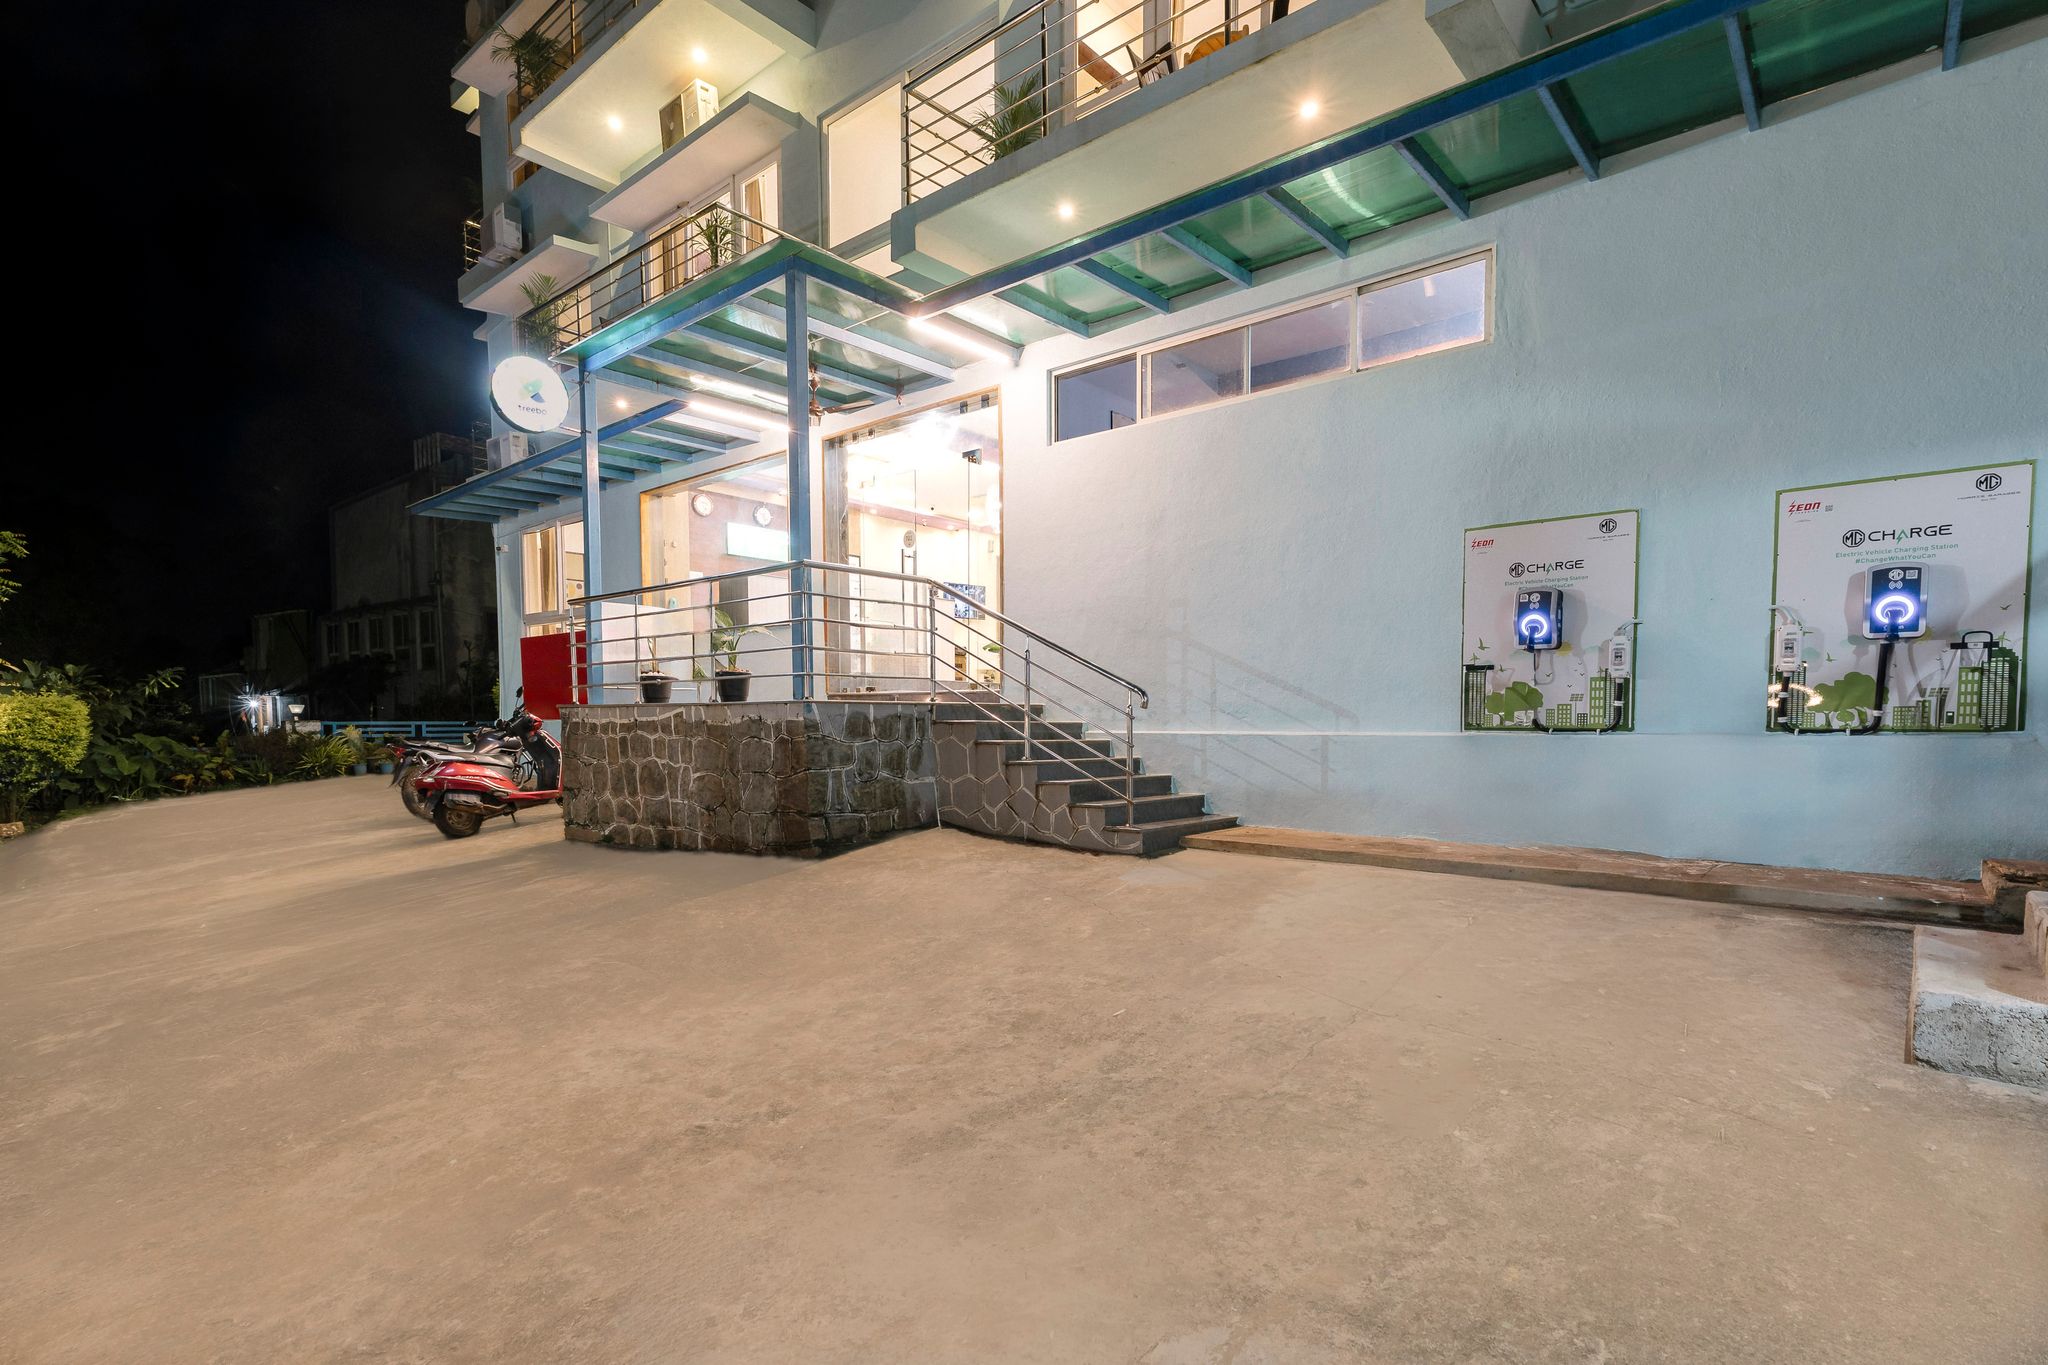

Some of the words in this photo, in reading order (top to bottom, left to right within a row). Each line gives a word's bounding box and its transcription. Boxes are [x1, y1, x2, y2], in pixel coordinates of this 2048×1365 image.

[1976, 473, 2002, 492] MG
[1599, 518, 1617, 533] MG
[1843, 529, 1865, 548] MG
[1868, 524, 1953, 544] CHARGE
[1835, 550, 1864, 558] Electric
[1865, 548, 1893, 556] Vehicle
[1894, 545, 1929, 554] Charging
[1930, 543, 1959, 551] Station
[1855, 553, 1937, 564] #ChangeWhatYouCan
[1509, 562, 1525, 578] MG
[1527, 560, 1584, 575] CHARGE
